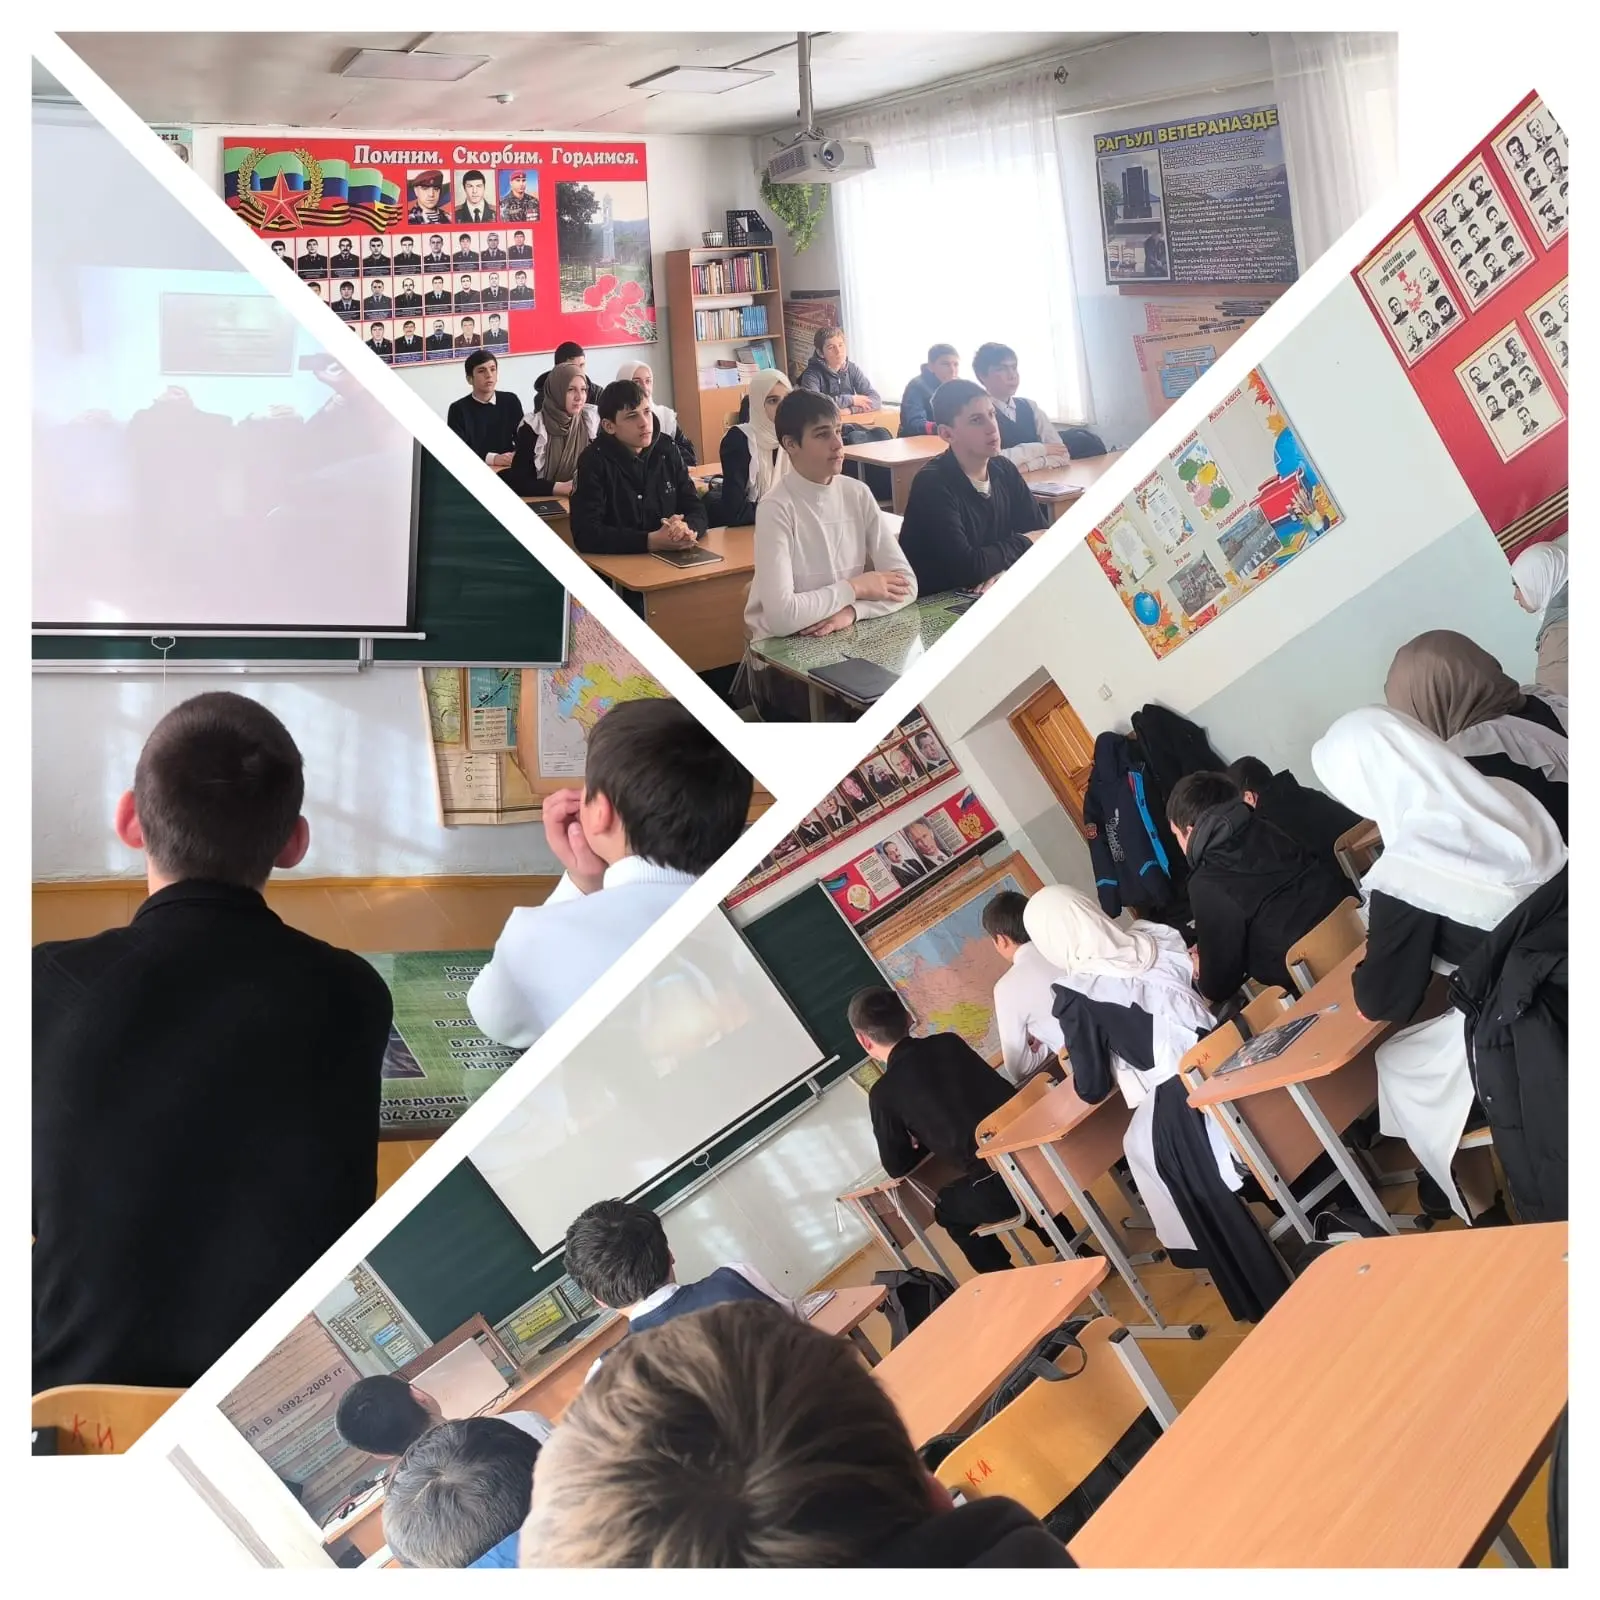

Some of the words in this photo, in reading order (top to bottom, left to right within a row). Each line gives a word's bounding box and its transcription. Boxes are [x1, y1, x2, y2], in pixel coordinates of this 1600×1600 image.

[1096, 130, 1153, 152] РАГЪУЛ
[1158, 109, 1279, 144] ВЕТЕРАНАЗДЕ
[354, 145, 444, 164] Помним.
[452, 144, 543, 168] Скорбим.
[552, 147, 639, 168] Гордимся.
[434, 1020, 446, 1028] В
[450, 1040, 463, 1048] В
[381, 1109, 454, 1121] 04.2022
[263, 1416, 273, 1426] В
